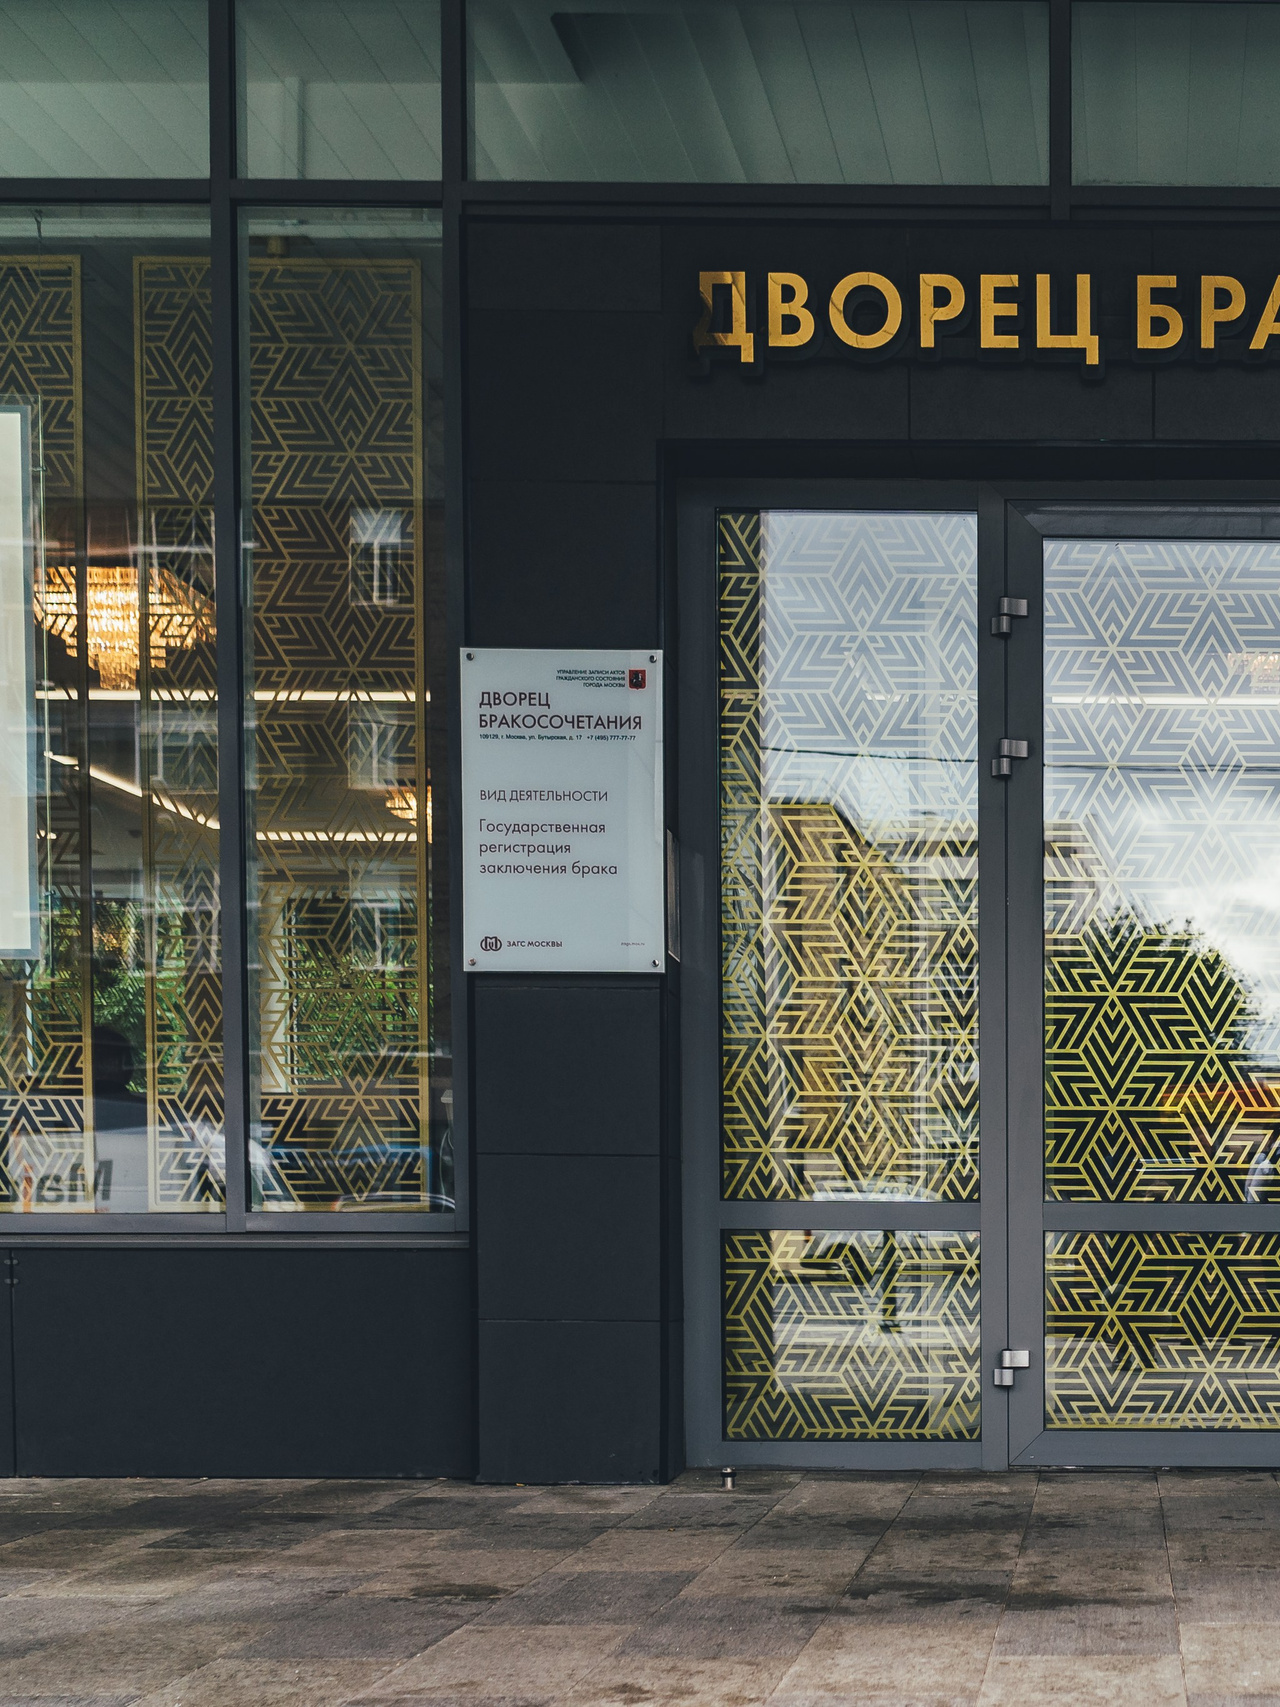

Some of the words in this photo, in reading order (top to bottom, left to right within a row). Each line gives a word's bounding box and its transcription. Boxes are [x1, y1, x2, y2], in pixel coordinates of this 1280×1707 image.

[694, 271, 1099, 365] ДВОРЕЦ
[479, 692, 550, 709] ДВОРЕЦ
[479, 714, 642, 730] БРАКОСОЧЕТАНИЯ
[480, 789, 506, 803] ВИД
[509, 789, 608, 803] ДЕЯТЕЛЬНОСТИ
[479, 818, 606, 837] Государственная
[479, 843, 571, 858] регистрация
[479, 864, 567, 875] заключения
[571, 859, 618, 878] брака
[506, 940, 525, 948] ЗАГС
[527, 940, 563, 948] МОСКВЫ
